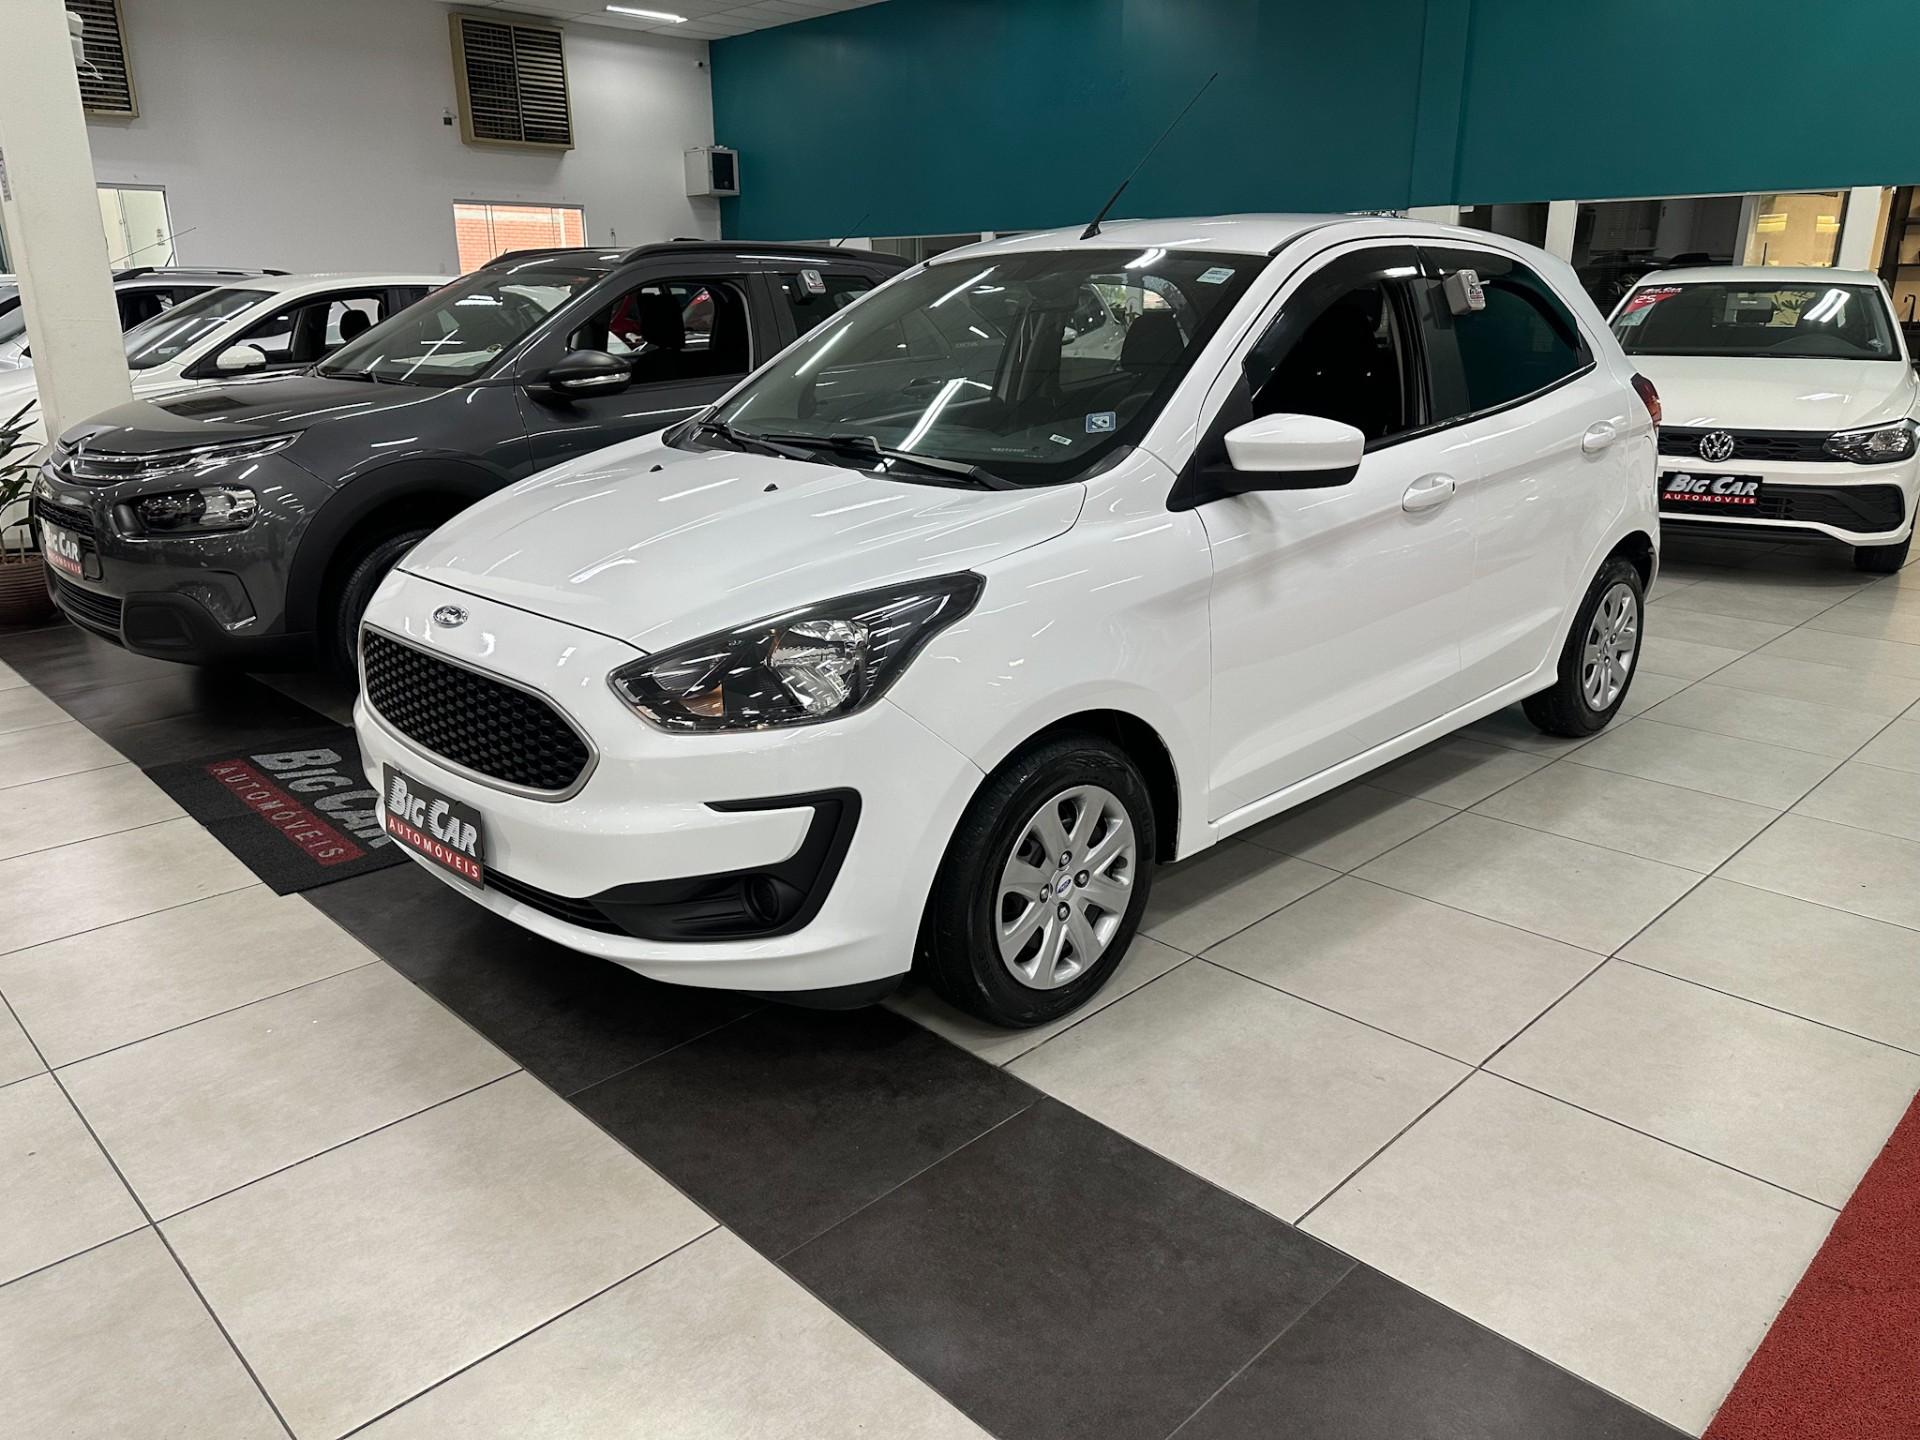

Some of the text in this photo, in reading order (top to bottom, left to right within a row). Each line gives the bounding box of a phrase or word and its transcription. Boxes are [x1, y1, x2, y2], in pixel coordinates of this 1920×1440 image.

[1665, 473, 1759, 496] BIG CAR
[251, 748, 353, 793] BIG
[387, 775, 477, 857] BIG CAR
[388, 818, 479, 878] AUTOMÓVEIS
